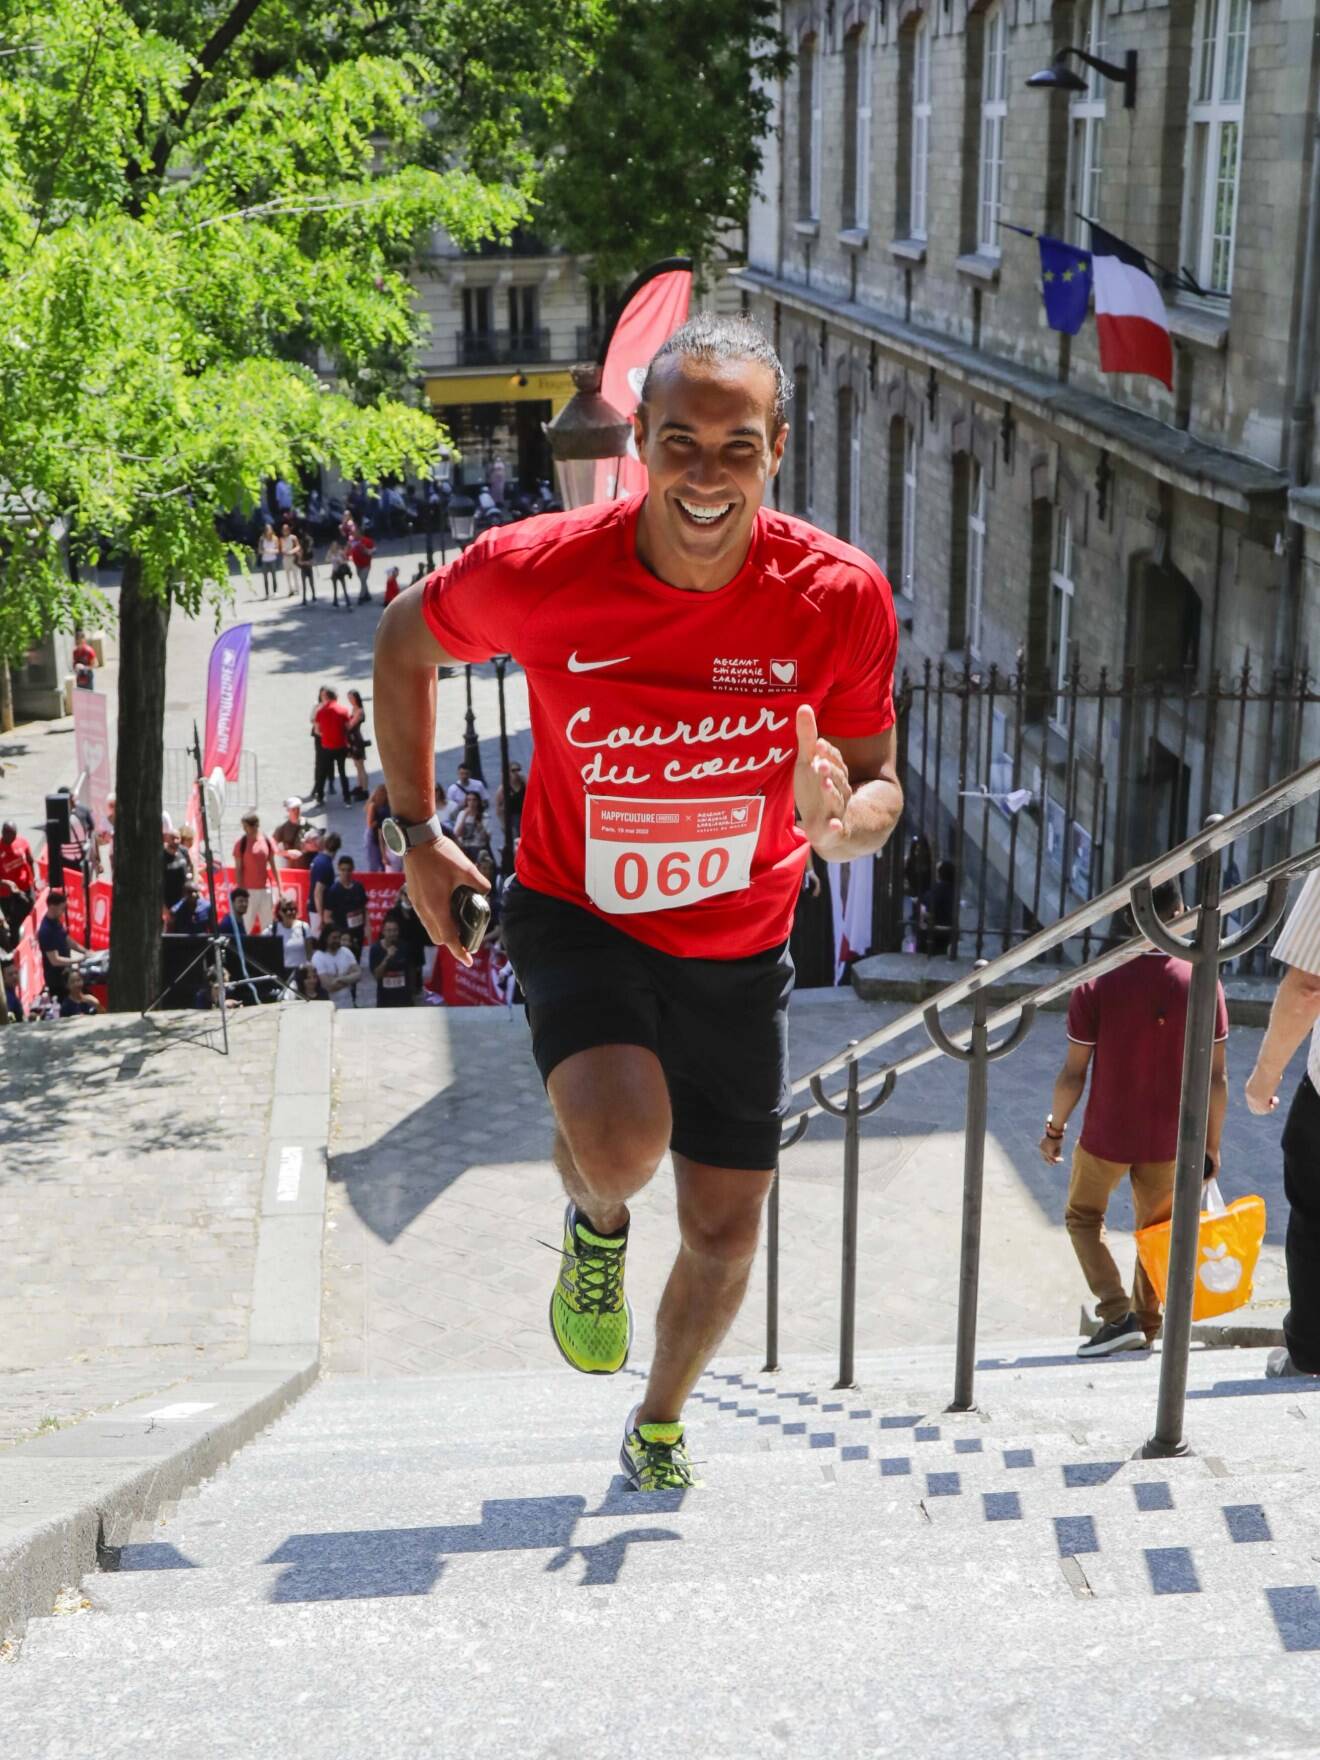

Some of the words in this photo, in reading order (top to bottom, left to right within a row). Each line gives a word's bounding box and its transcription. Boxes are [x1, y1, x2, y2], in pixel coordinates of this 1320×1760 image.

[217, 664, 235, 753] HAPPYCULTURE
[565, 706, 789, 749] Coureur
[580, 752, 651, 785] du
[664, 746, 793, 782] cœur
[601, 810, 656, 823] HAPPYCULTURE
[614, 847, 730, 900] 060
